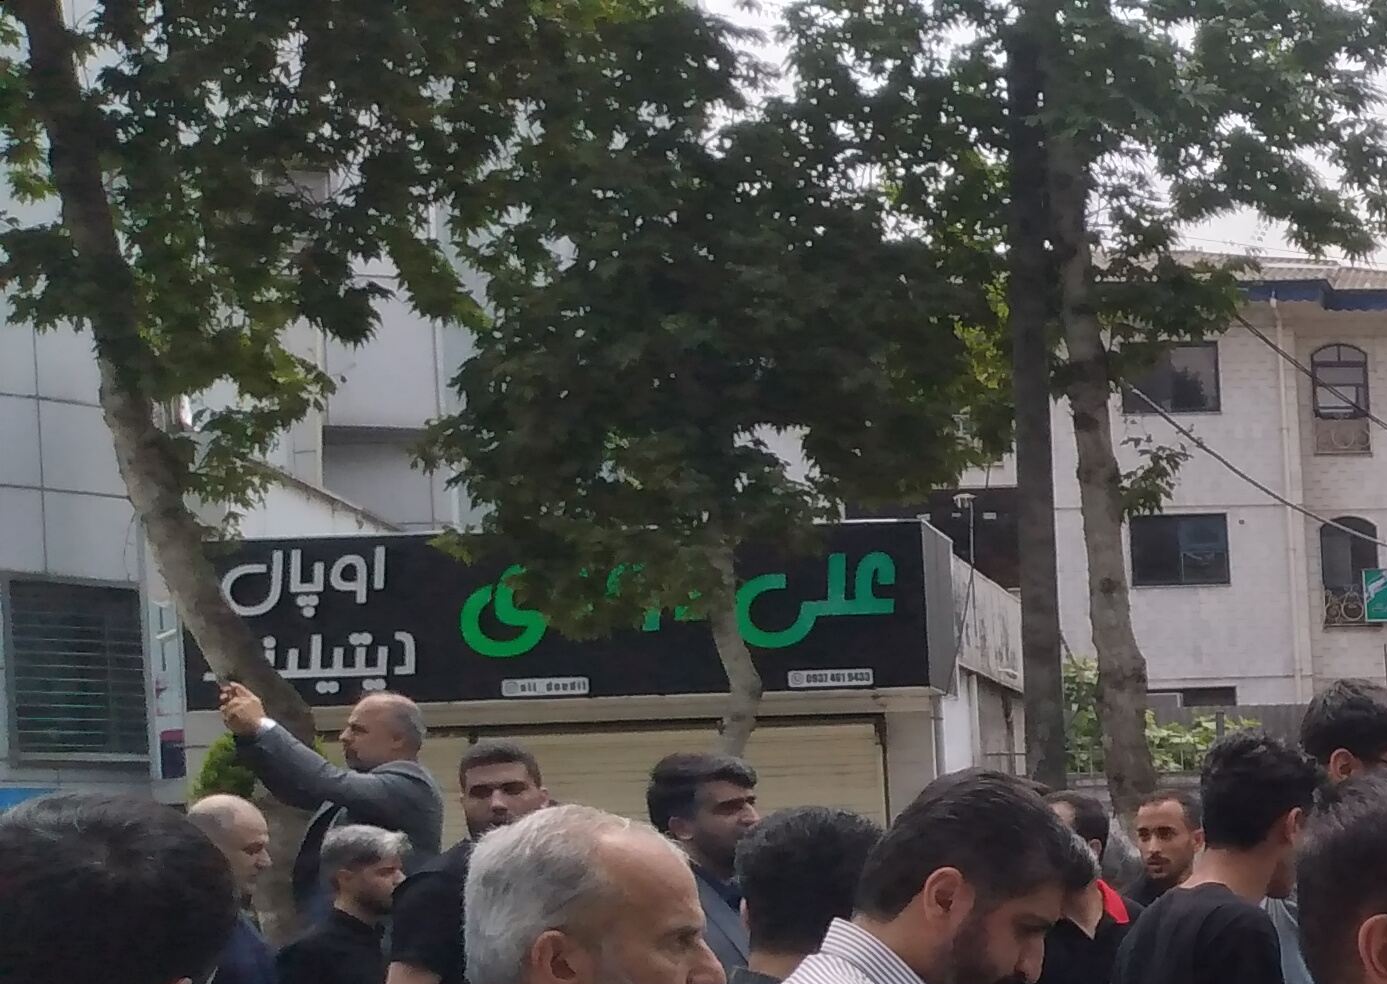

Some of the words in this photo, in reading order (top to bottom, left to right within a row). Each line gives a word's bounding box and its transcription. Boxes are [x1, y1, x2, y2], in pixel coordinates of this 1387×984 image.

[221, 545, 386, 617] اوپال
[735, 551, 896, 648] علی
[203, 631, 416, 694] دیتیلین
